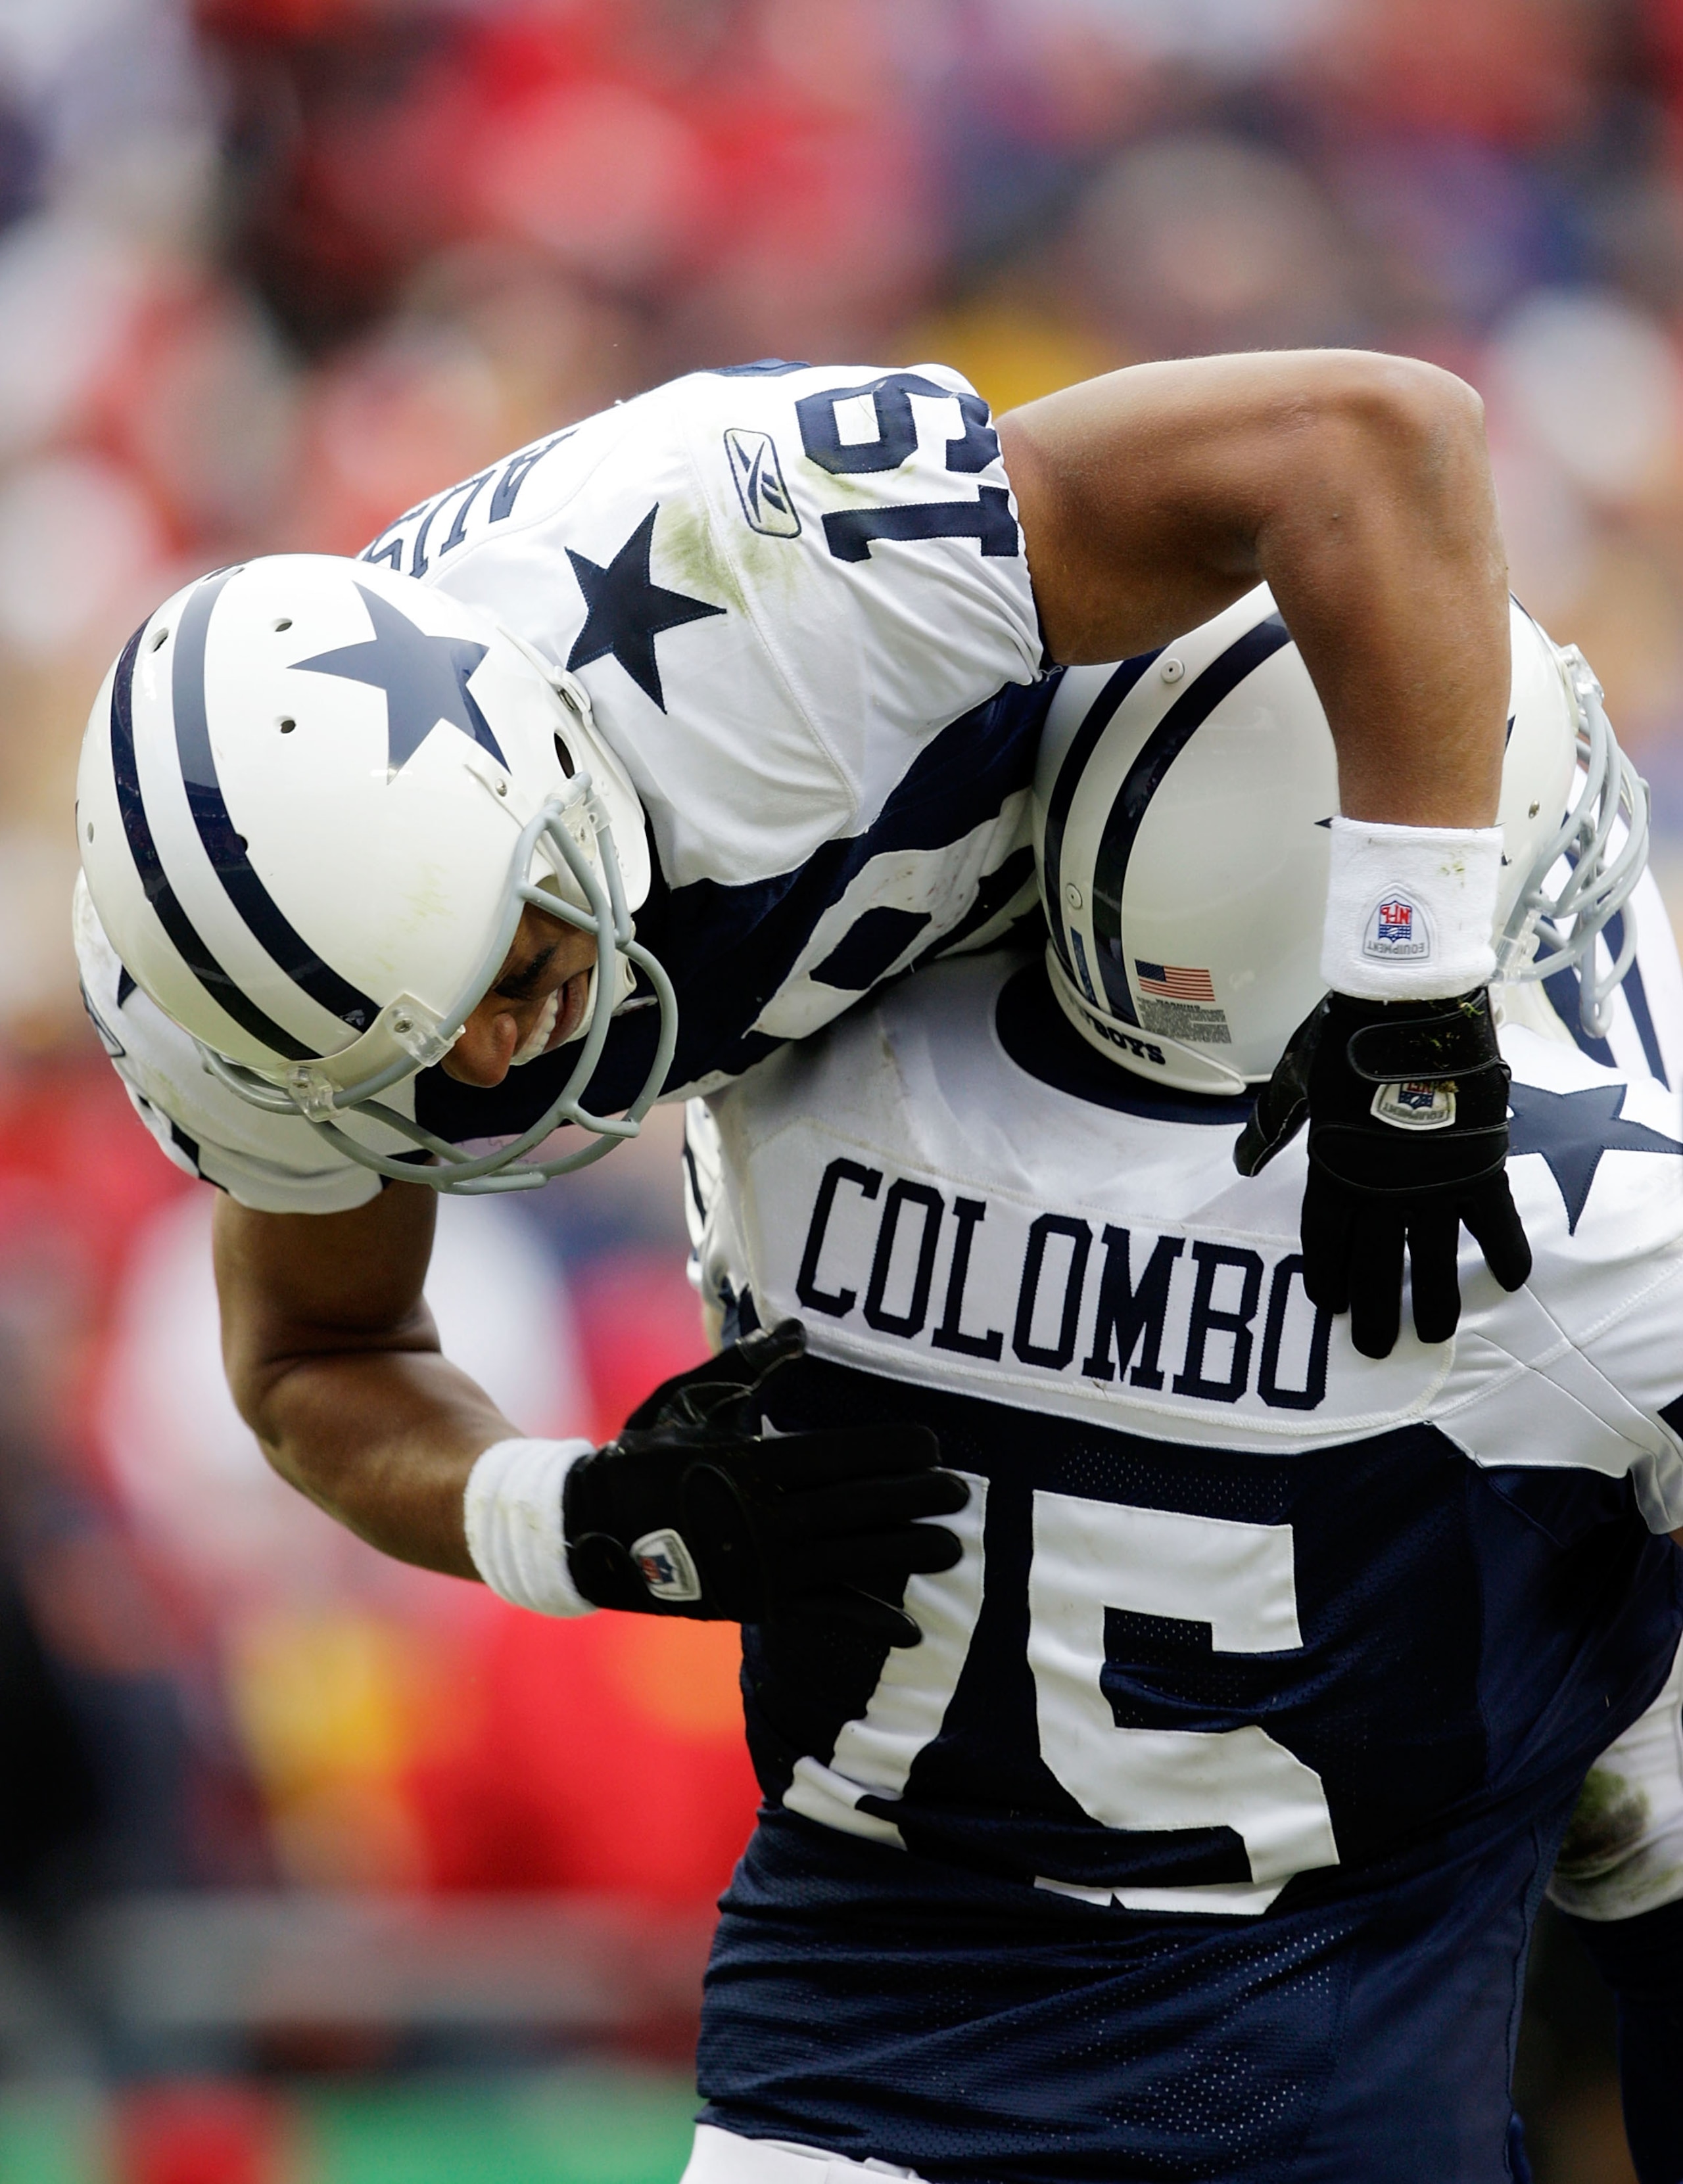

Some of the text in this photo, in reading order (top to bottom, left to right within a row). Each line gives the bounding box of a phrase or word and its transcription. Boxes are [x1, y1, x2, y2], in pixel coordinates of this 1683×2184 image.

[794, 372, 1020, 563] 19
[1367, 941, 1425, 955] EQUIPMENT
[1381, 904, 1411, 925] NFL
[796, 1157, 1333, 1410] COLOMBO
[782, 1466, 1340, 1915] 75
